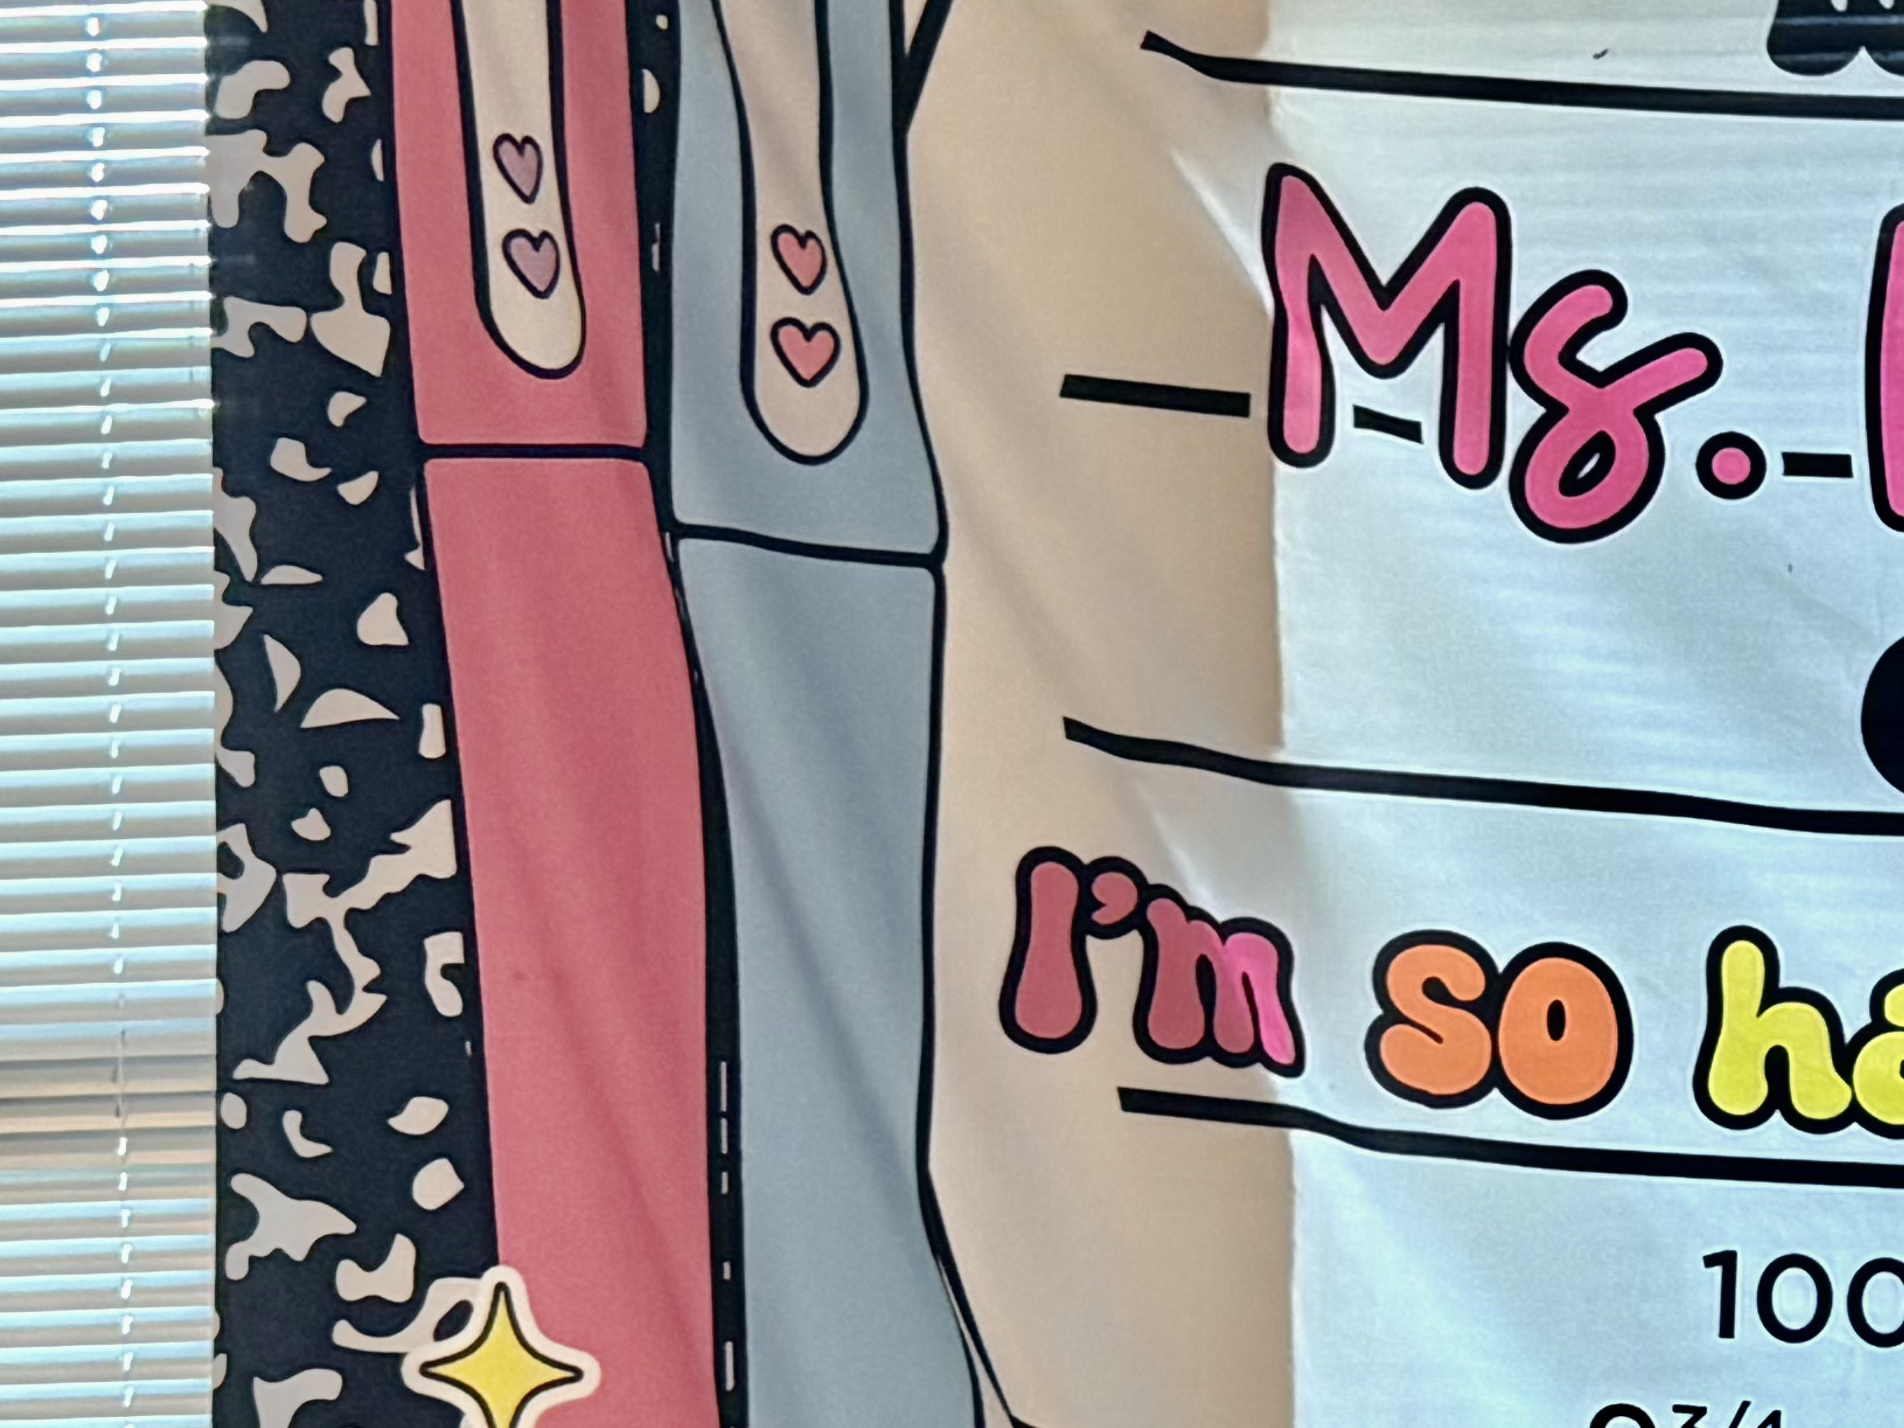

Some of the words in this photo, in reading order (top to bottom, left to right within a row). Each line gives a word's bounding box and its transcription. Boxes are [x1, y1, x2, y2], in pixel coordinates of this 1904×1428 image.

[1261, 162, 1766, 543] Ms.
[1000, 846, 1304, 1078] I'm
[1366, 928, 1634, 1120] so
